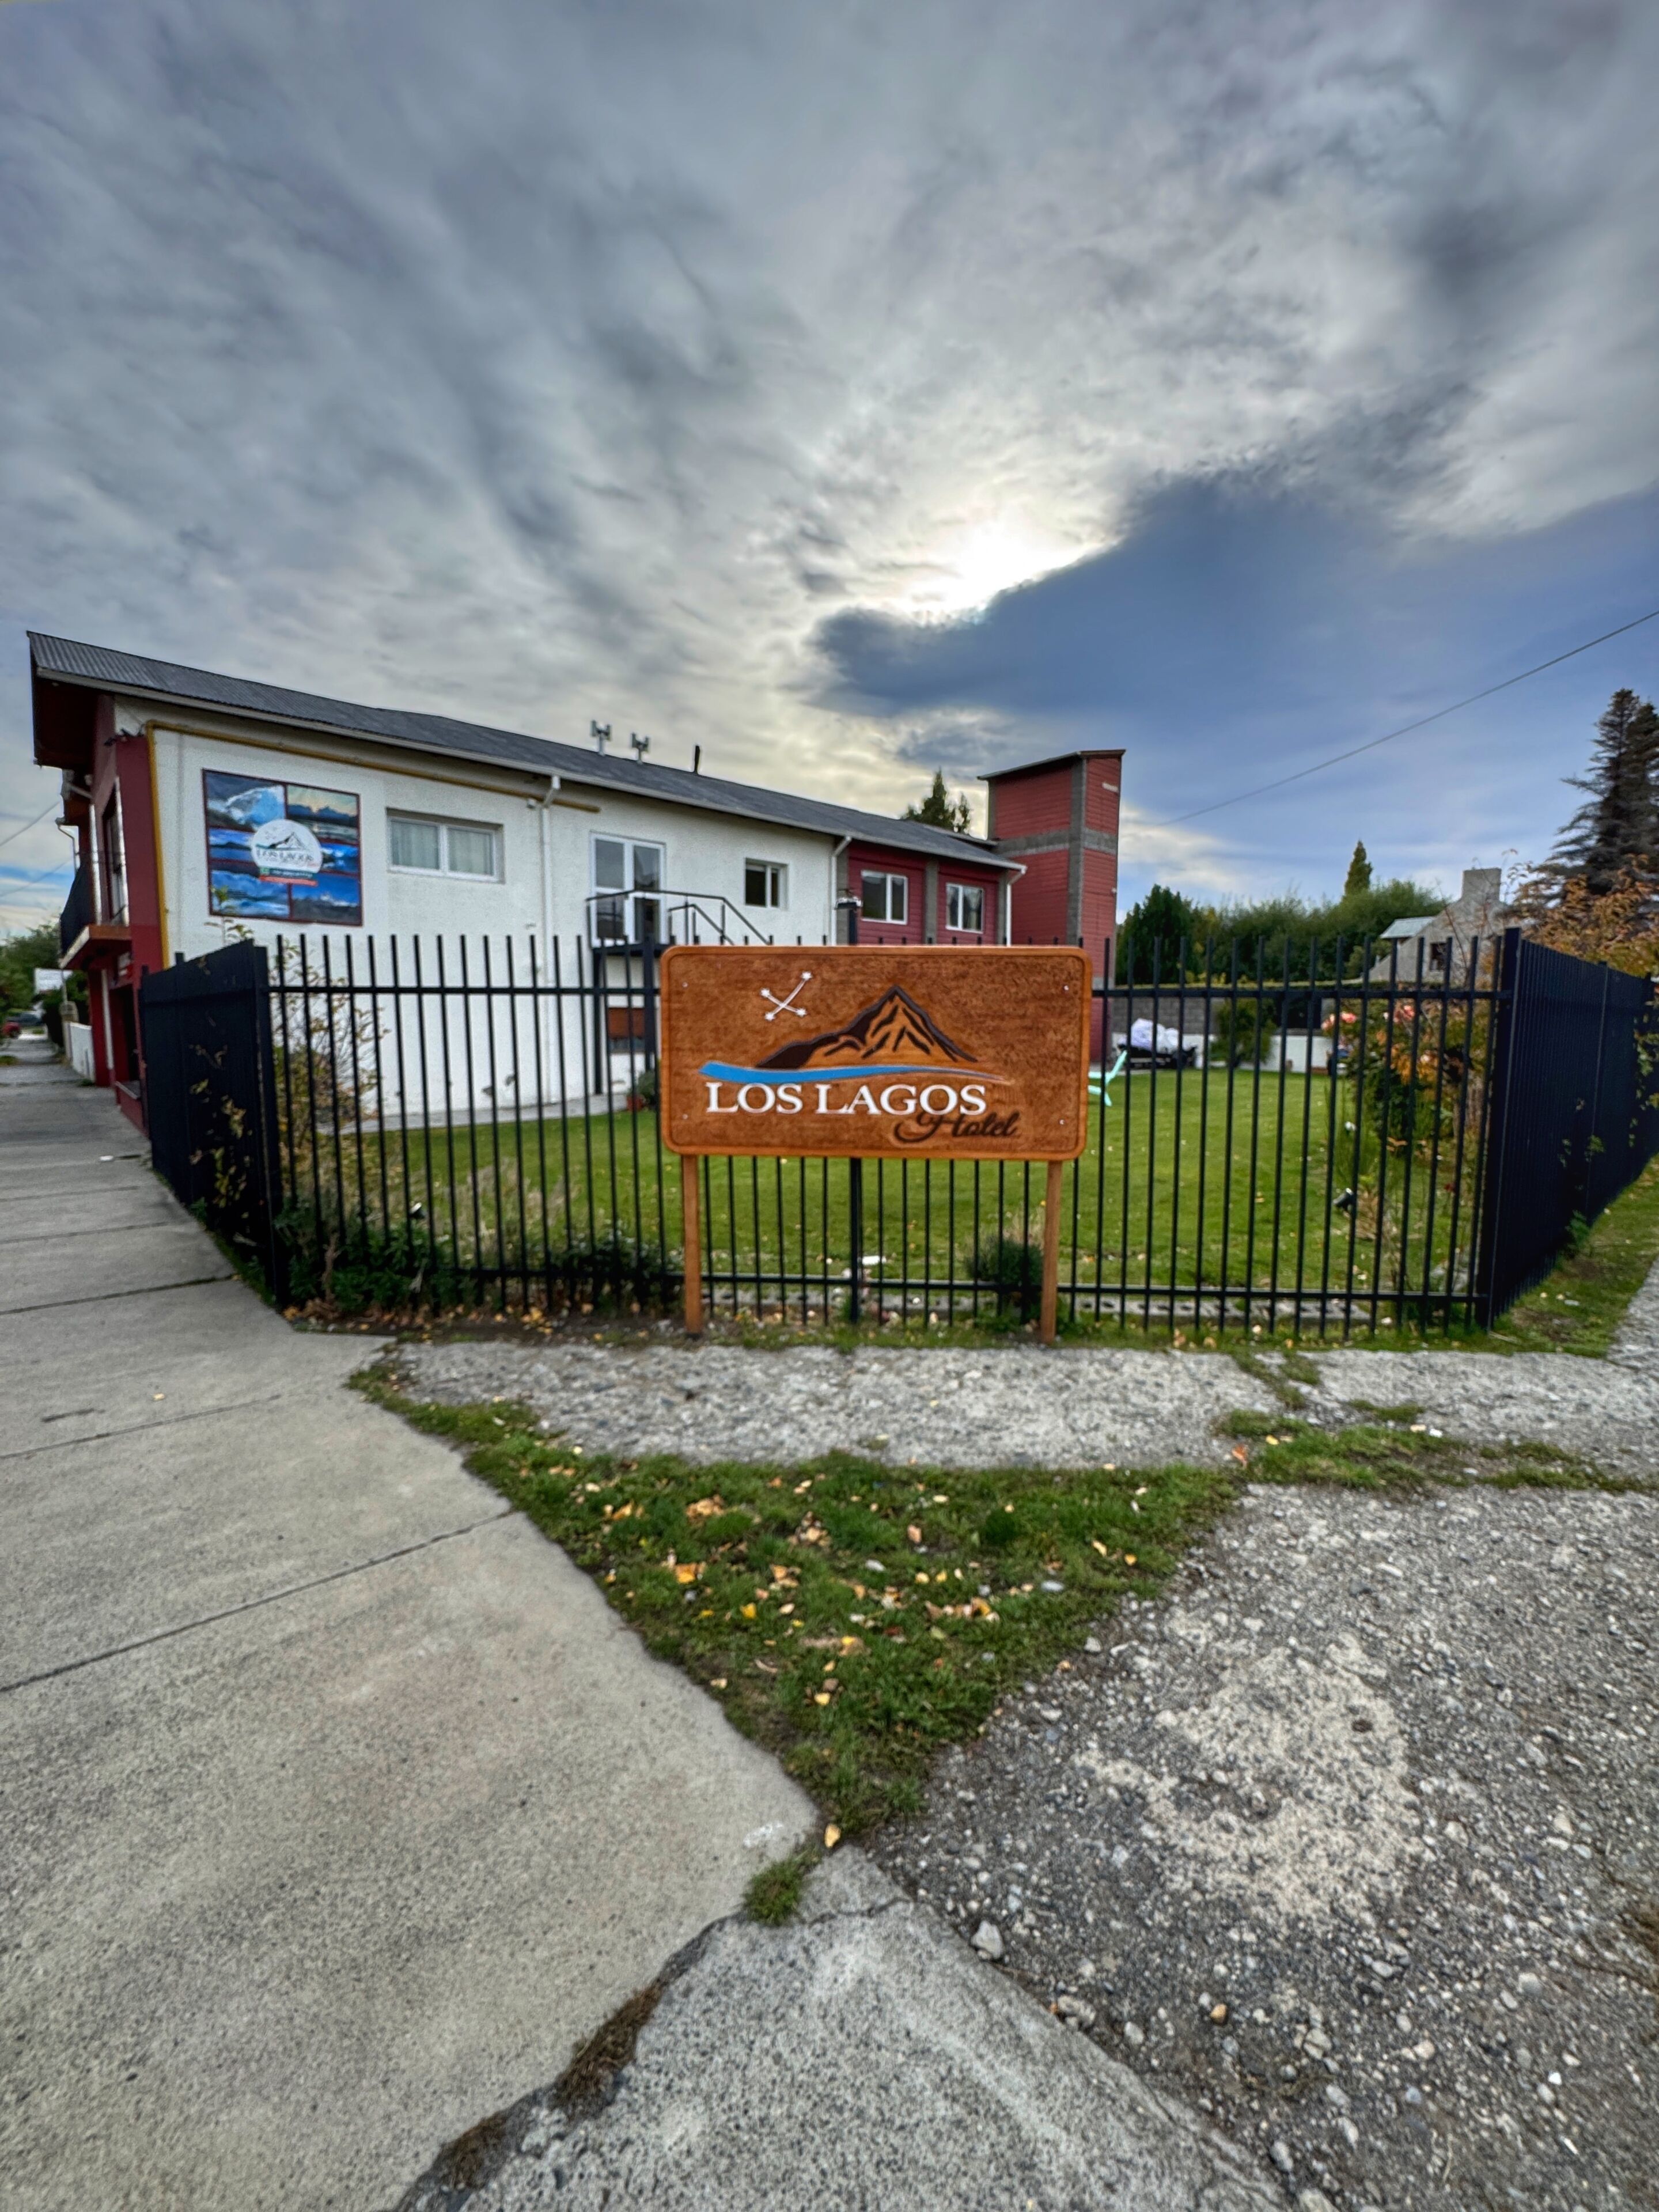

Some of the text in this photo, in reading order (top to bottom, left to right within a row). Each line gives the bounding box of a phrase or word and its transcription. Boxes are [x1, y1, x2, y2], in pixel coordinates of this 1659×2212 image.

[705, 1082, 987, 1115] LOS LAGOS
[894, 1111, 1020, 1143] Hotel
